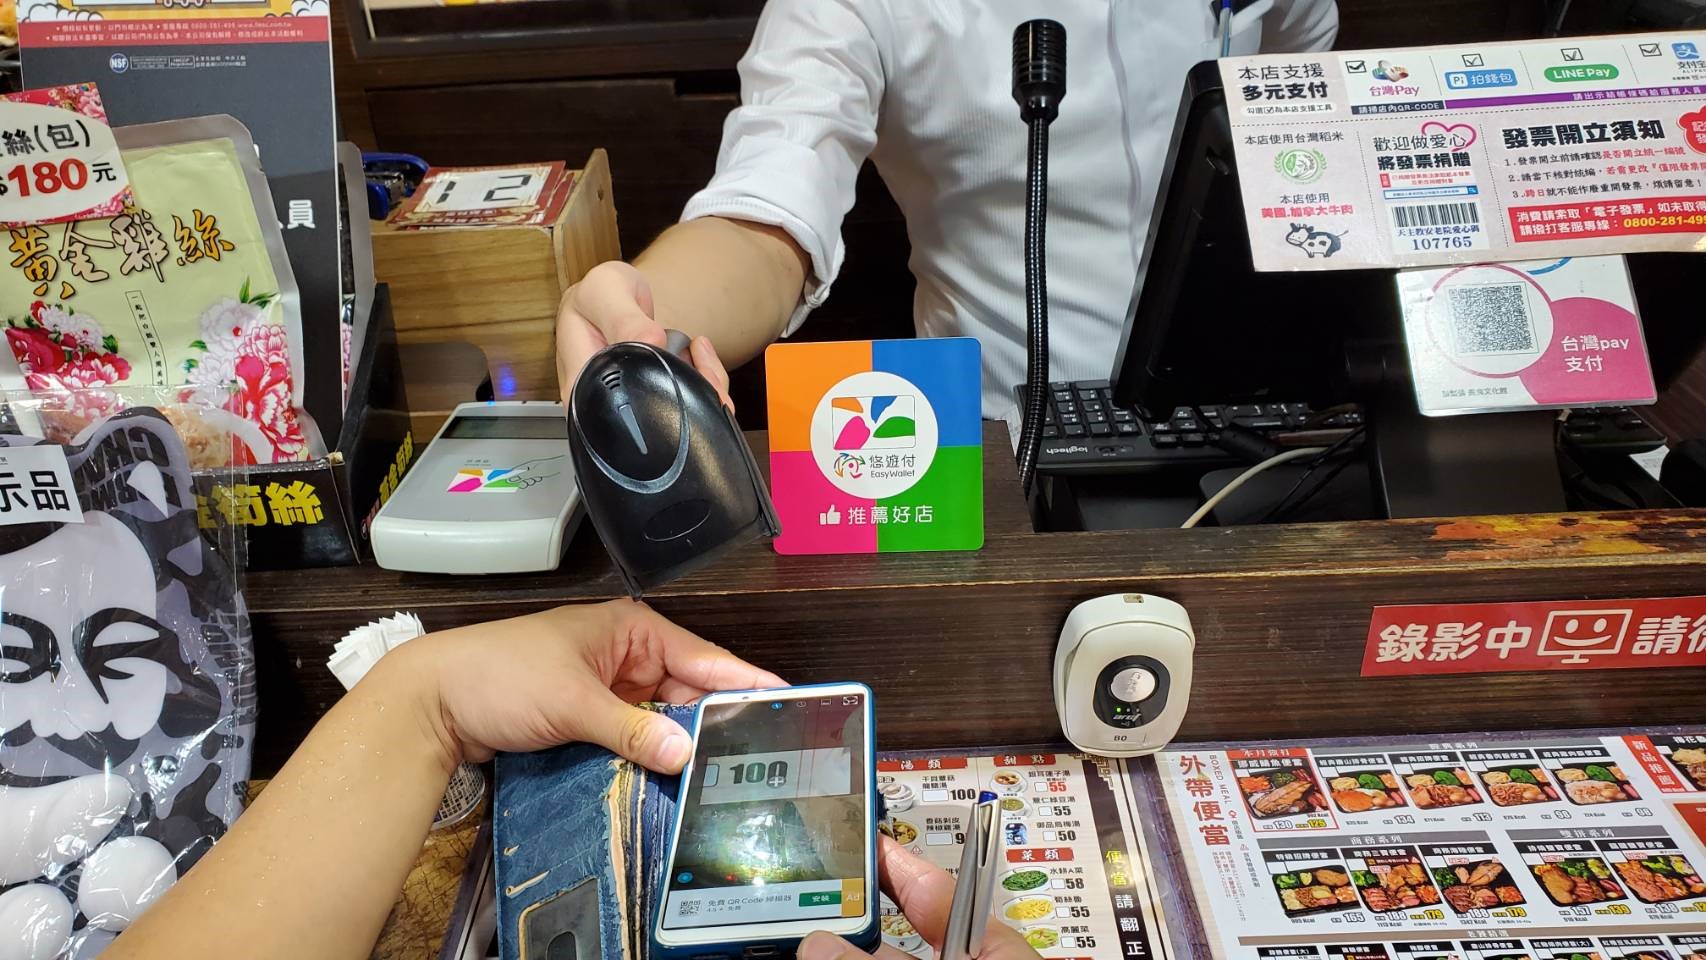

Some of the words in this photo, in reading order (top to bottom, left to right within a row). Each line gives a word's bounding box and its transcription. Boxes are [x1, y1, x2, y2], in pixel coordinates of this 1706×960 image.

[1238, 62, 1325, 80] 本店支援
[1553, 68, 1584, 80] LINE
[1586, 66, 1613, 79] Pay
[1453, 75, 1465, 87] Pi
[1471, 72, 1513, 86] 拍錢包
[1242, 81, 1328, 101] 多元支付
[1369, 84, 1420, 97] 台灣Pay
[0, 119, 91, 157] 絲(包)
[1244, 131, 1345, 145] 本店使用台灣稻米
[1502, 119, 1666, 150] 發票開立須知
[1374, 133, 1468, 152] 歡迎做愛心
[1377, 152, 1472, 171] 將發票捐贈
[92, 162, 116, 182] 元
[1279, 193, 1330, 204] 本店使用
[1411, 236, 1473, 251] 107765
[1561, 335, 1630, 352] 台灣pay
[1566, 355, 1604, 373] 支付
[1046, 445, 1089, 455] logitech
[869, 454, 916, 469] 悠遊付
[870, 470, 915, 479] EasyWallet
[848, 506, 933, 525] 推薦好店
[1376, 620, 1532, 663] 錄影中
[1049, 781, 1067, 792] 55
[1209, 754, 1224, 781] BOXED
[1220, 784, 1232, 805] MEAL
[950, 788, 977, 800] 100
[1179, 753, 1231, 846] 外帶便當
[1053, 805, 1071, 816] 55
[1393, 814, 1415, 824] 134
[1058, 830, 1077, 842] 50
[1065, 878, 1085, 890] 58
[846, 893, 860, 901] Ad
[1071, 905, 1090, 918] 55
[1344, 912, 1364, 923] 165
[1425, 910, 1444, 920] 179
[1507, 907, 1526, 917] 179
[1076, 936, 1096, 949] 55
